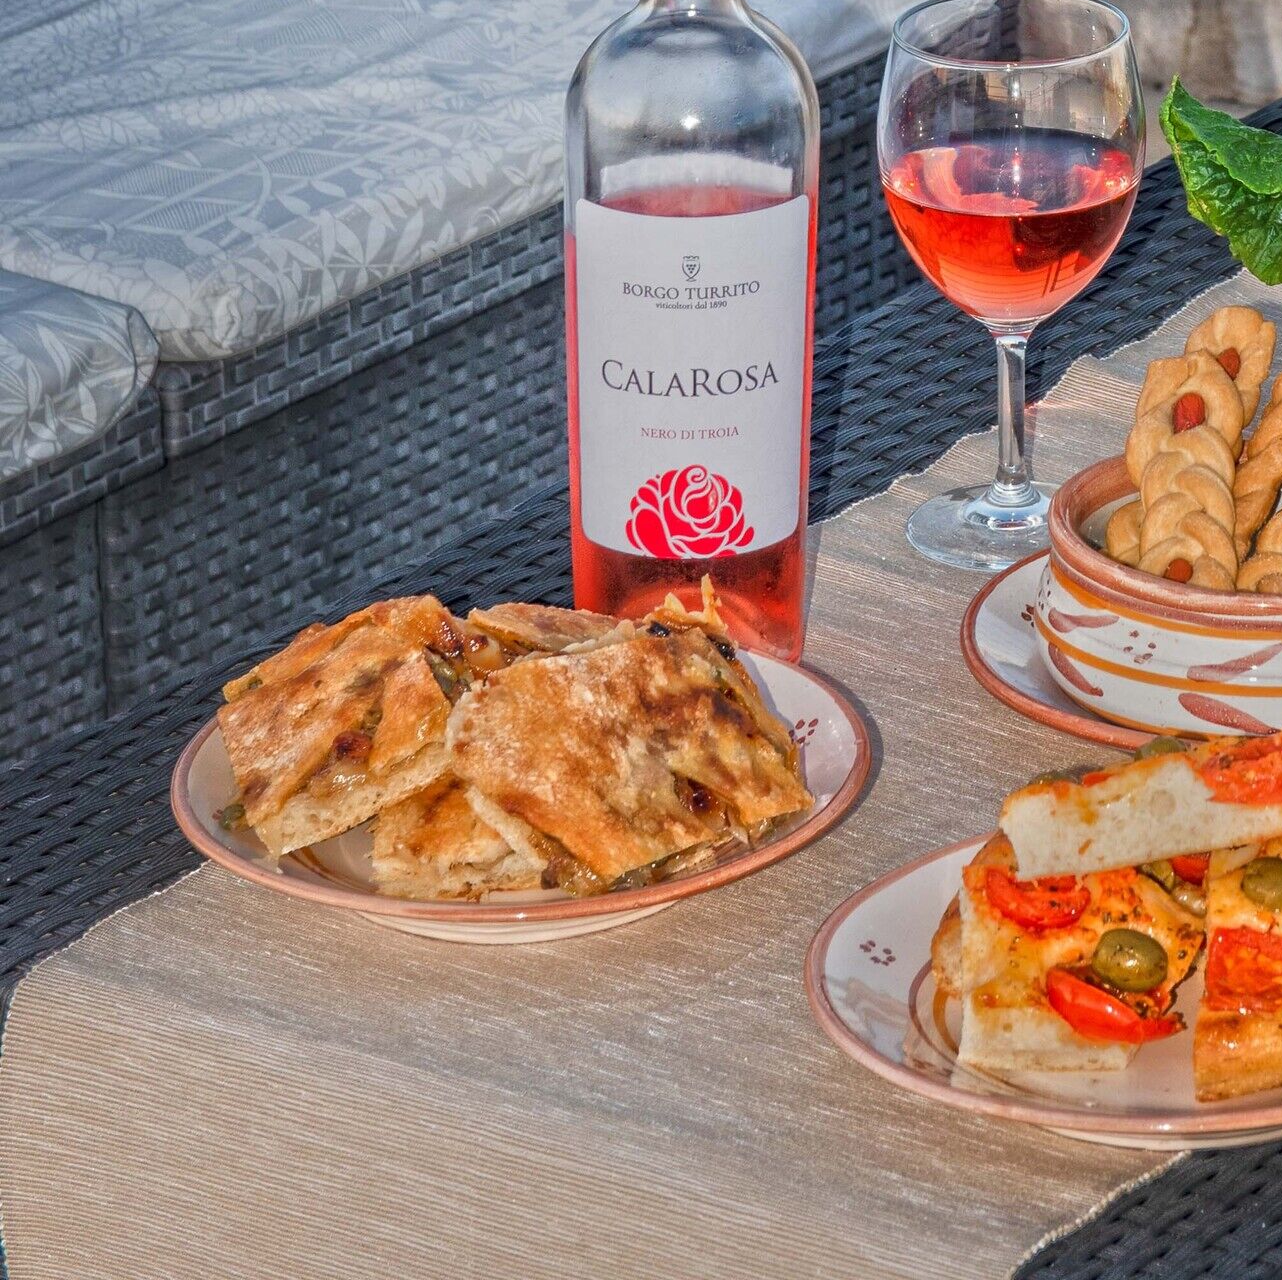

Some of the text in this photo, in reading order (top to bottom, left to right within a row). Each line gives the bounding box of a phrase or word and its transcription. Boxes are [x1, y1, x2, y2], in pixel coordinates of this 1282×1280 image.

[622, 280, 761, 300] BORGO TURRITO
[655, 300, 728, 310] viticoltori dal 1890
[641, 425, 740, 441] NERO DI TROIA
